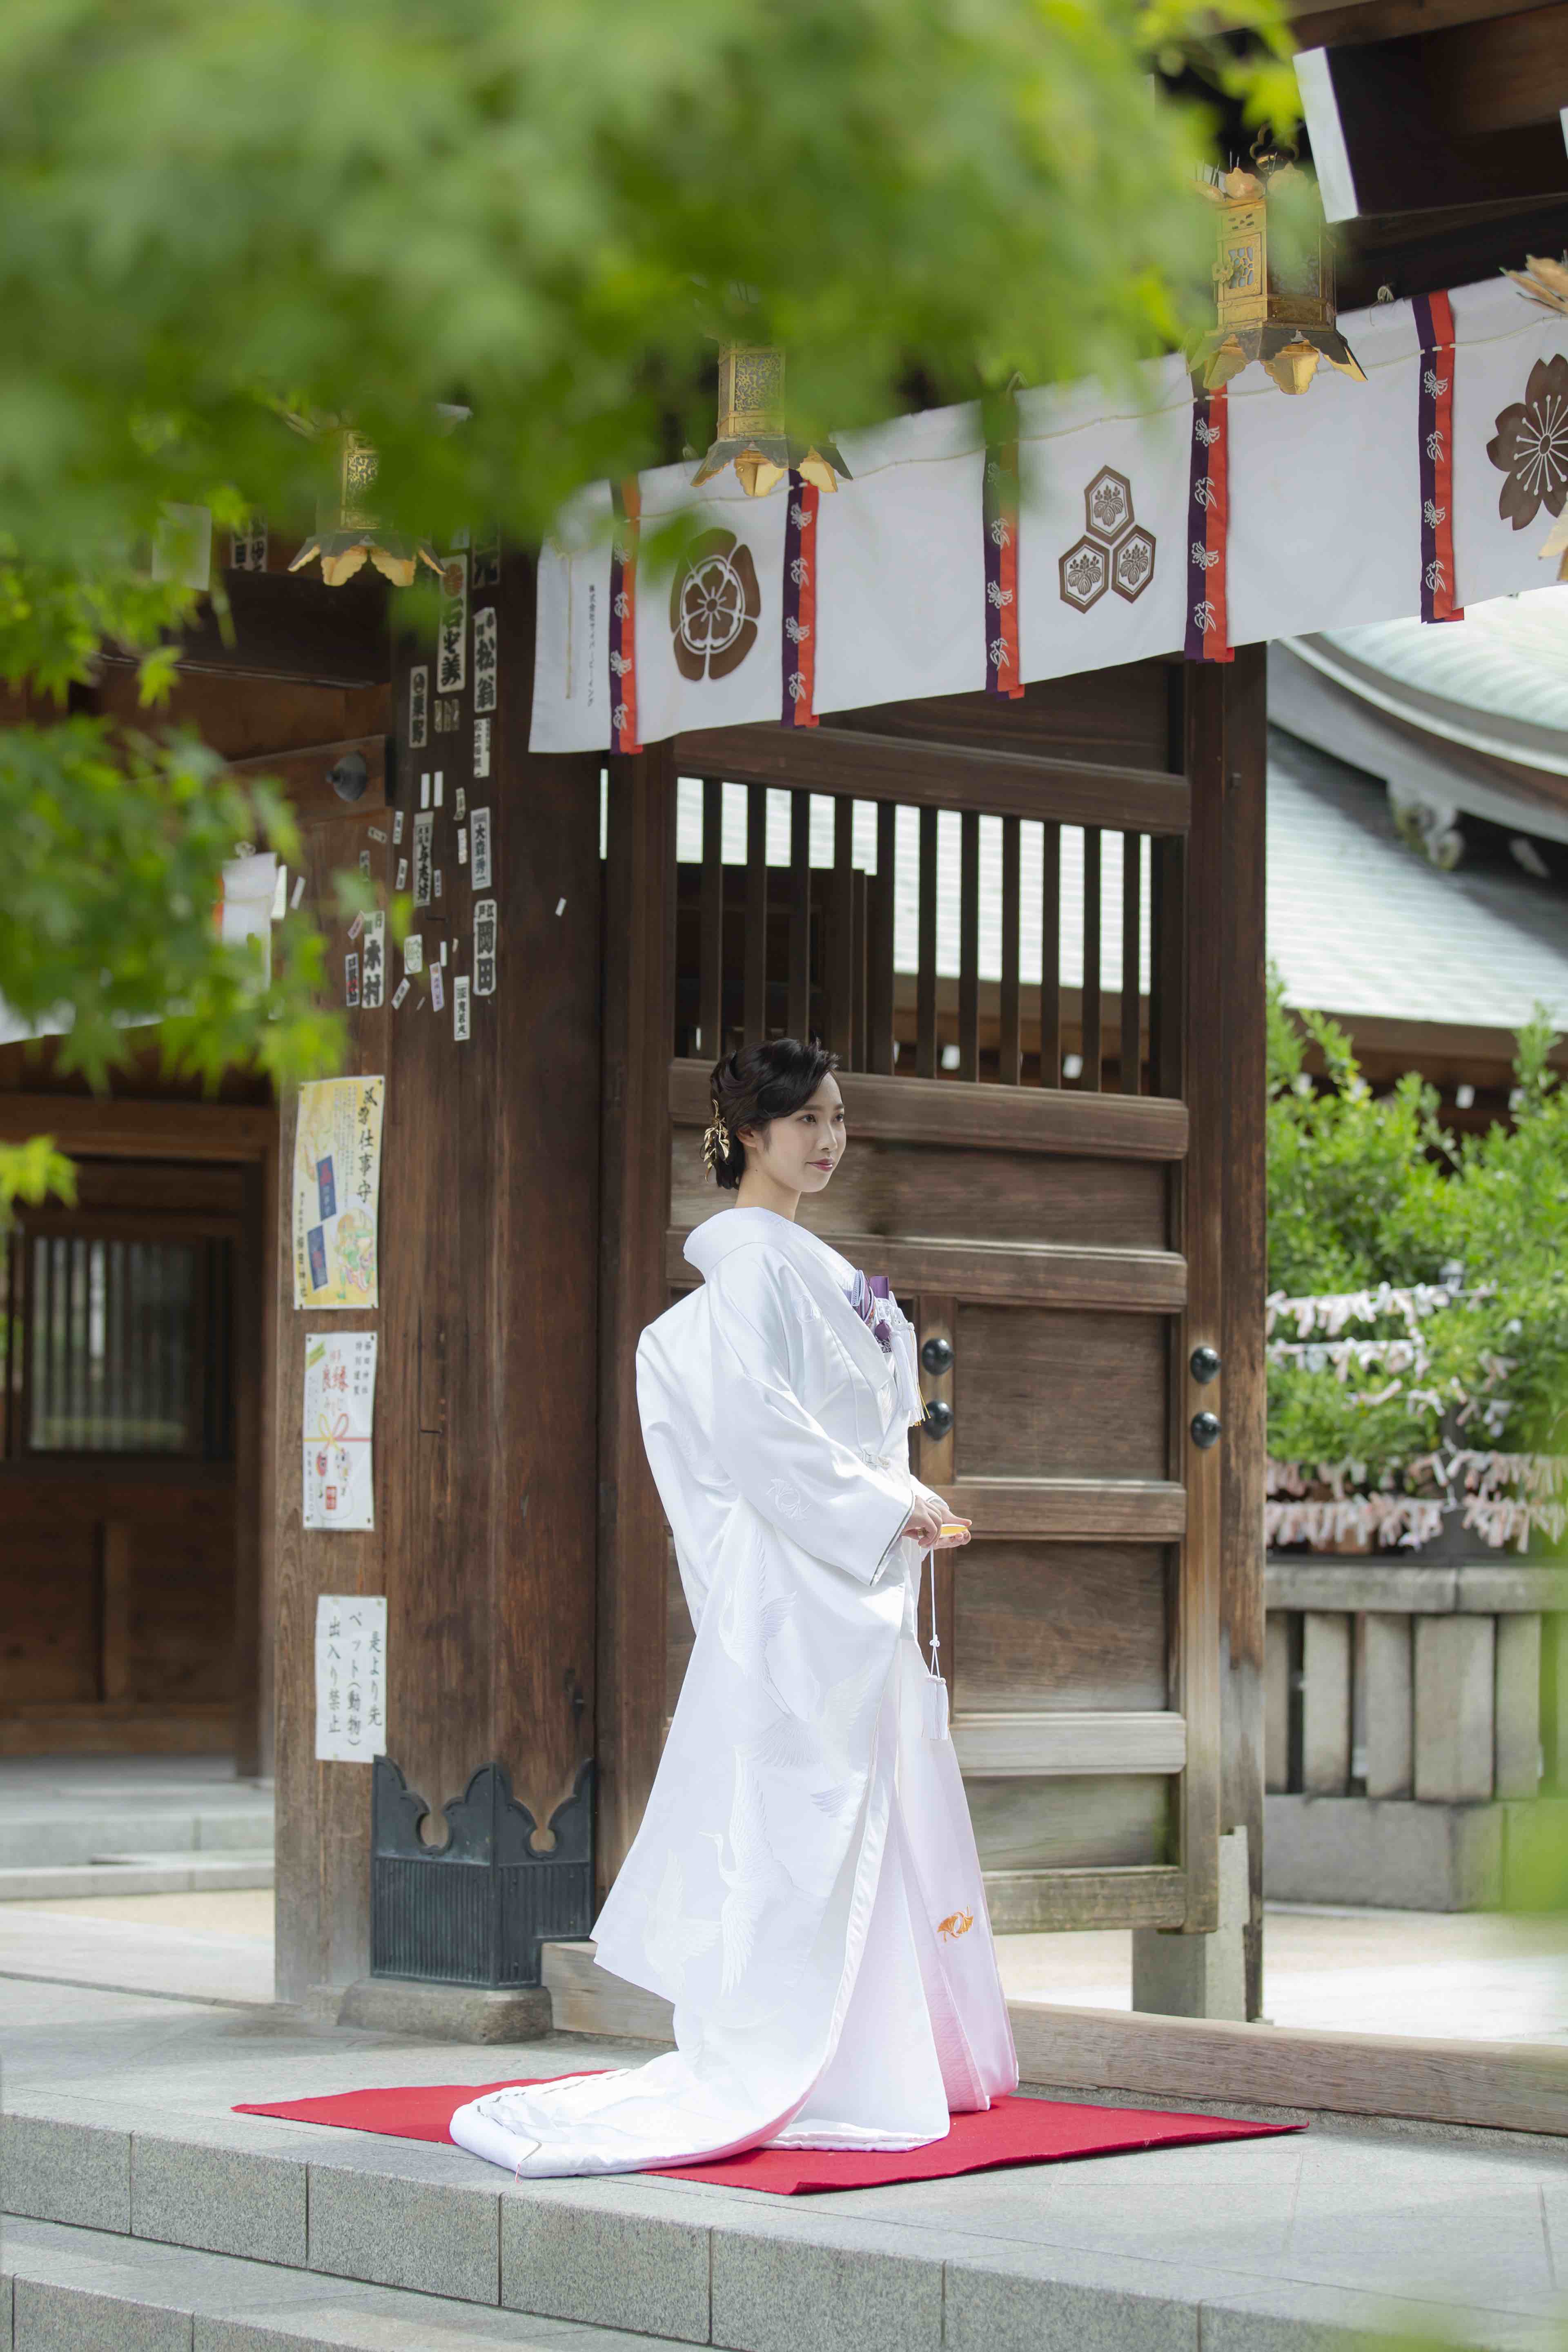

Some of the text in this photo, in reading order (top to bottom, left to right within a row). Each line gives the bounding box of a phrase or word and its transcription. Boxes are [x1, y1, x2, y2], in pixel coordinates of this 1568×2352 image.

[327, 1616, 341, 1733] 出入り禁止
